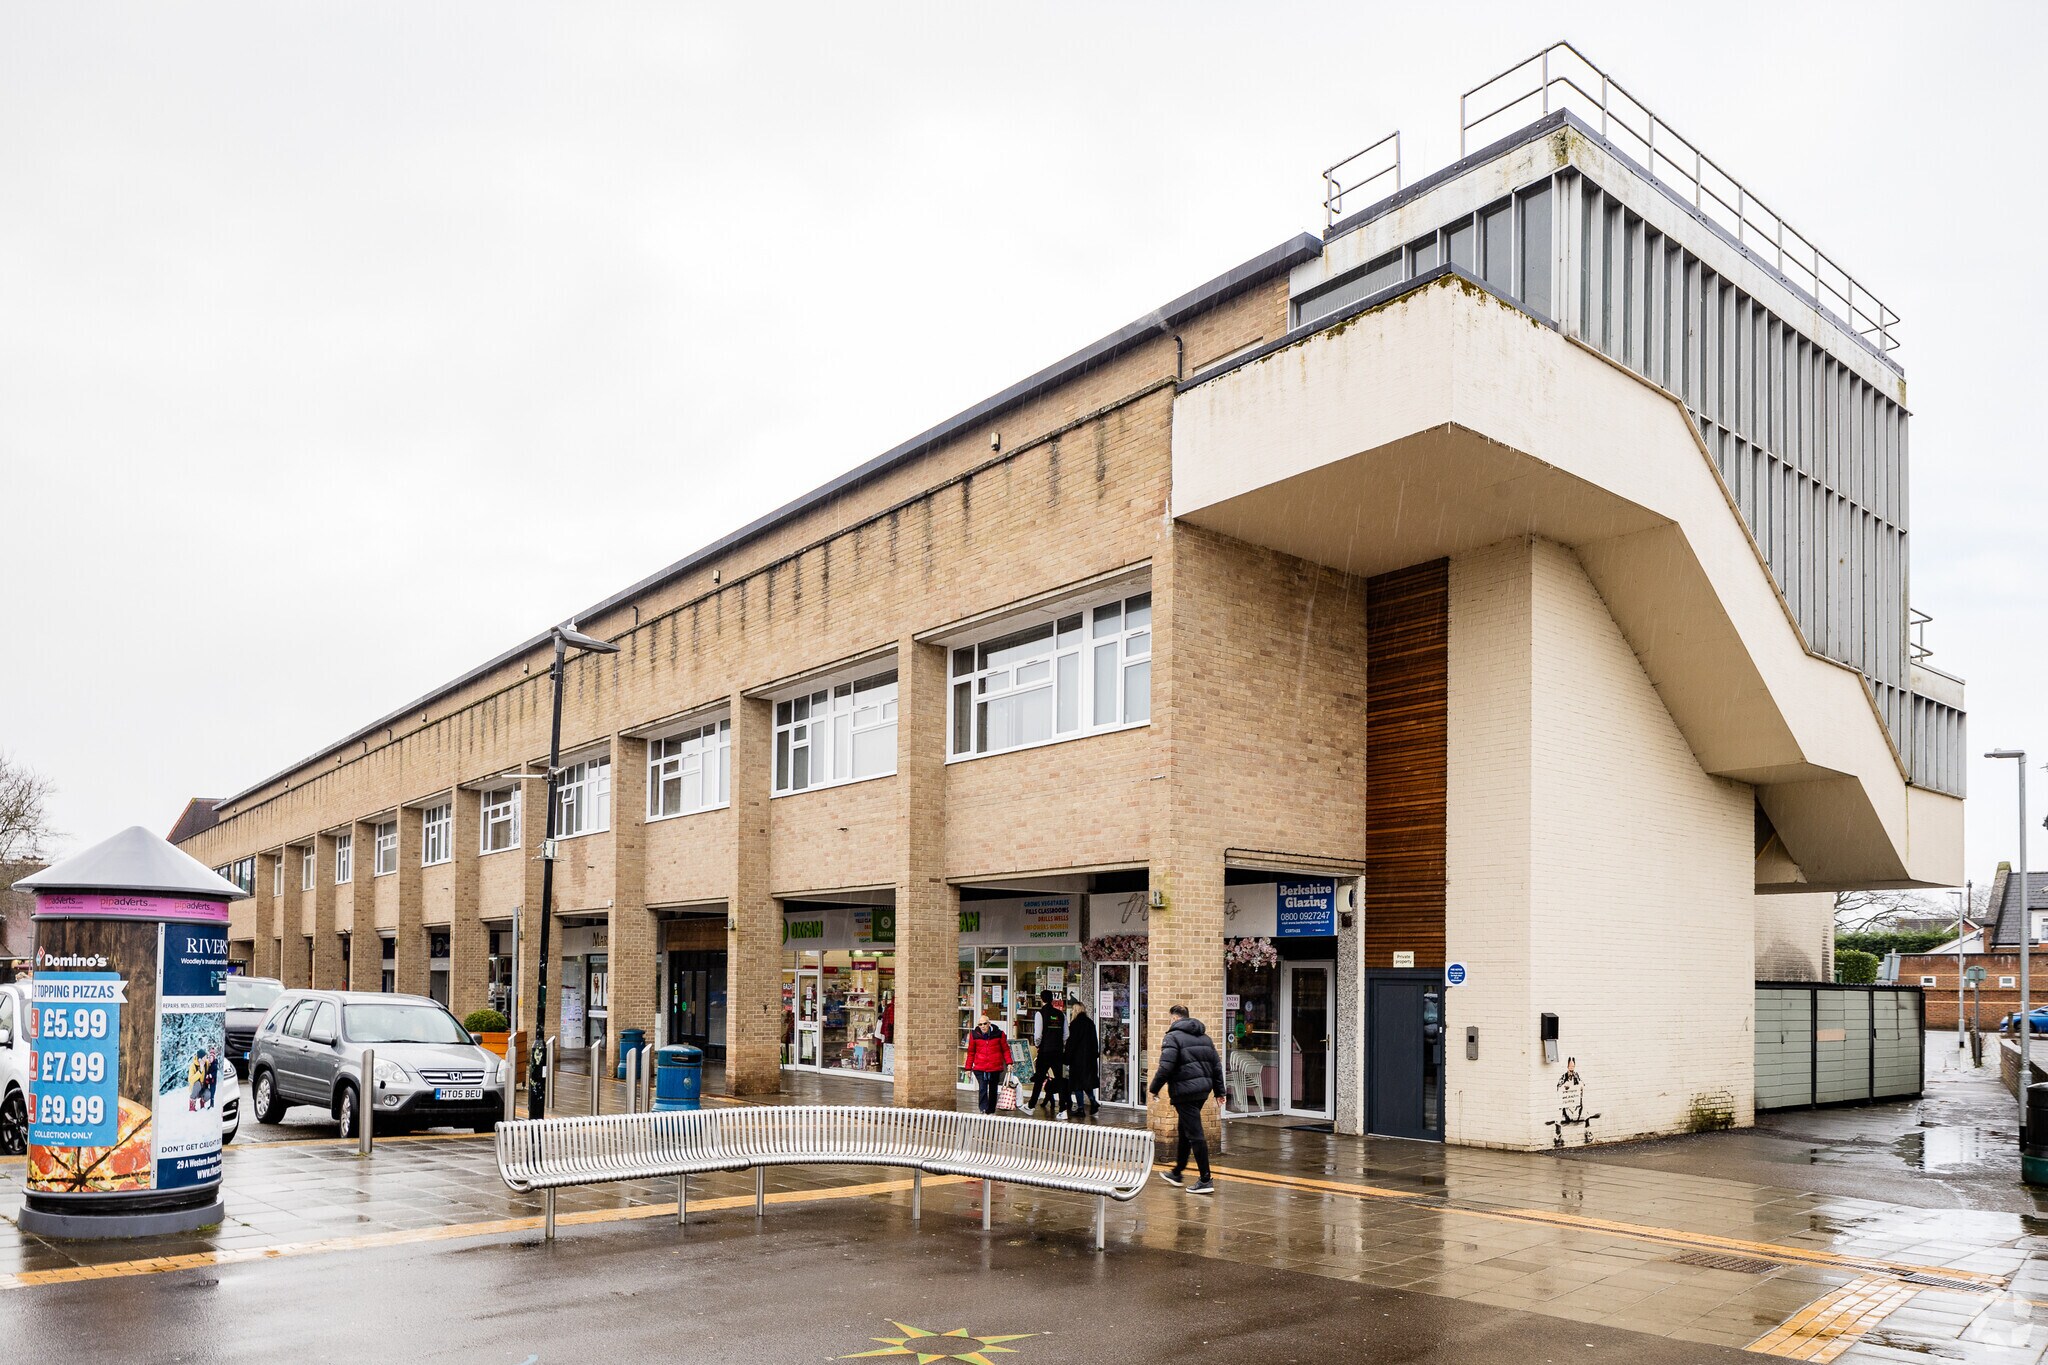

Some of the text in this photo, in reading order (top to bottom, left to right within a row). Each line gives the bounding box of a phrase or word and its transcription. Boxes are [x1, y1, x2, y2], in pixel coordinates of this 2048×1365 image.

[1280, 884, 1331, 896] Berkshire
[1041, 899, 1069, 907] VEGETABLES
[1285, 895, 1328, 909] Glazing
[1280, 911, 1331, 921] 0800 0927247
[790, 920, 824, 939] OXFAM
[45, 953, 106, 968] Domino's
[38, 984, 70, 998] TOPPING
[72, 984, 114, 999] PIZZAS
[43, 1008, 108, 1039] £5.99
[42, 1051, 106, 1082] £7.99
[441, 1090, 482, 1098] HT05 BEU
[41, 1094, 105, 1125] £9.99
[34, 1130, 93, 1140] COLLECTION ONLY
[161, 1144, 185, 1153] DON'T
[185, 1143, 199, 1151] GET
[176, 1160, 185, 1170] 29
[184, 1159, 190, 1169] A
